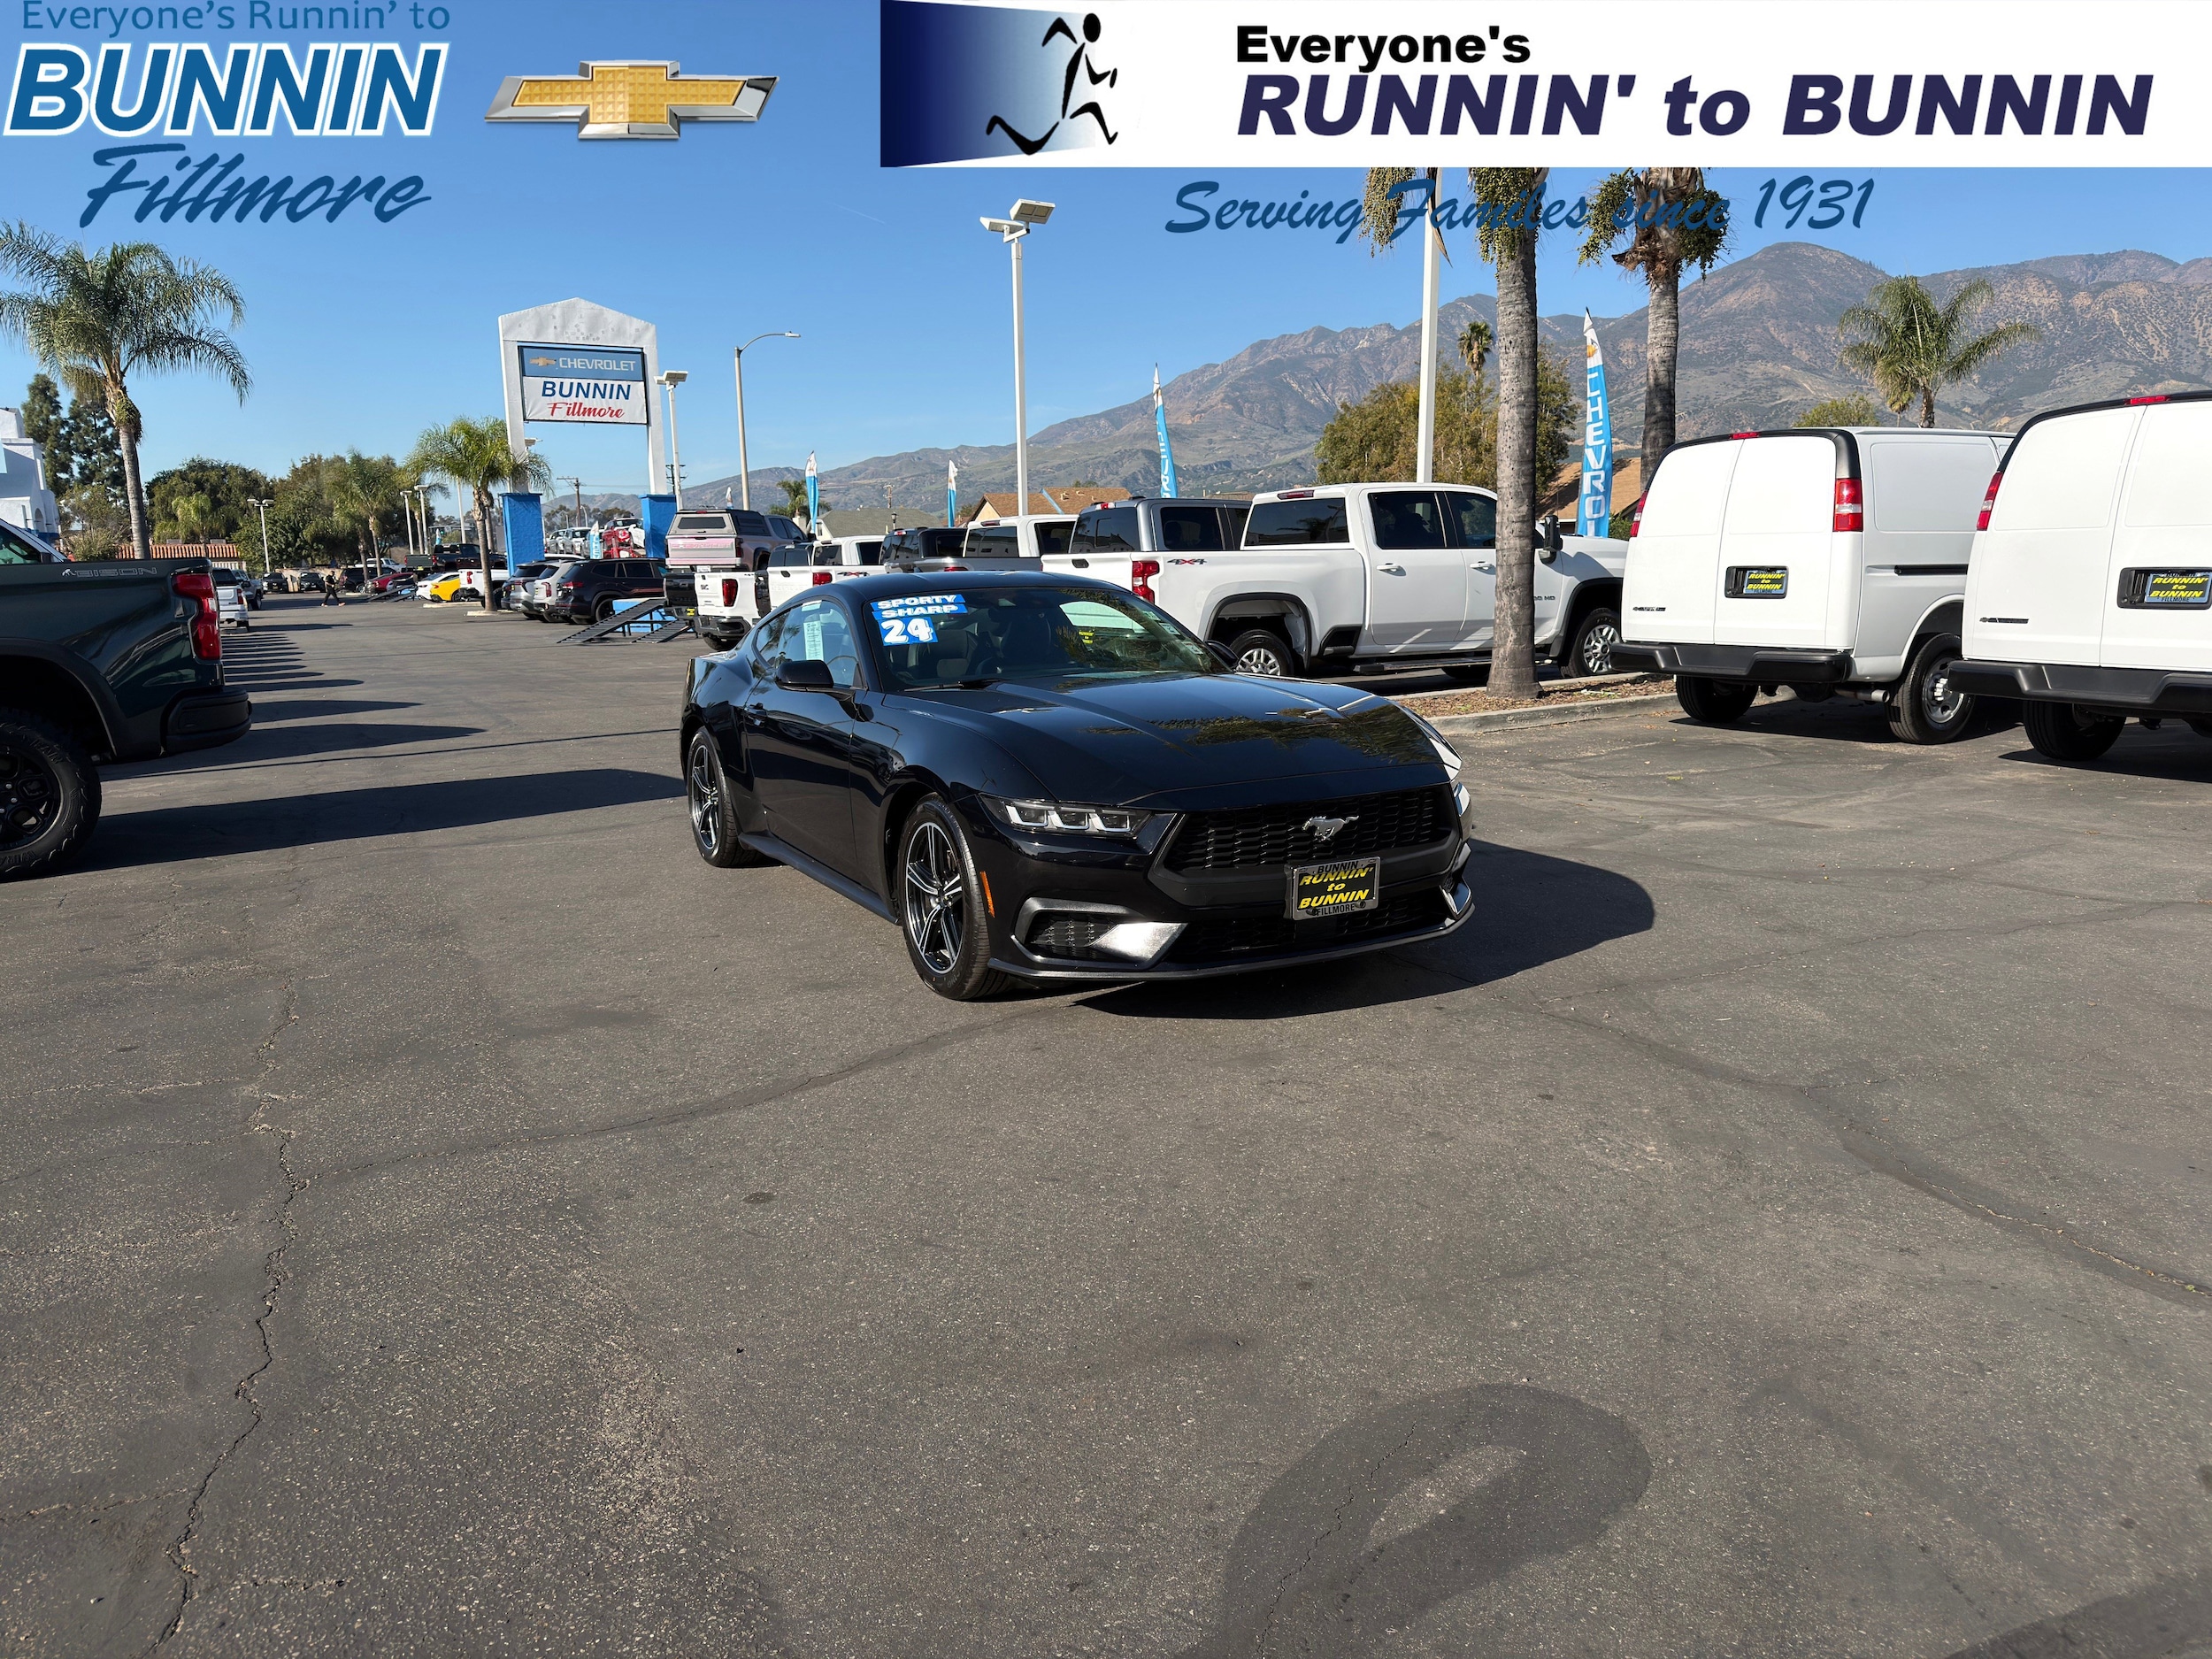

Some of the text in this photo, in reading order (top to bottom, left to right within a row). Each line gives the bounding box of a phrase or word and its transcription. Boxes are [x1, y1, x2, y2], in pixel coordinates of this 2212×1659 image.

[559, 357, 636, 372] CHEVROLET
[541, 380, 631, 400] BUNNIN
[547, 402, 625, 419] Fillmore
[76, 567, 157, 577] BISON
[877, 594, 957, 610] SPORTY
[881, 604, 959, 618] SHARP
[880, 618, 933, 643] 24
[1317, 860, 1359, 874] BUNNIN
[1299, 866, 1374, 886] RUNNIN'
[1327, 883, 1346, 892] to
[1298, 889, 1370, 910] BUNNIN
[1317, 902, 1356, 917] FILLMORE
